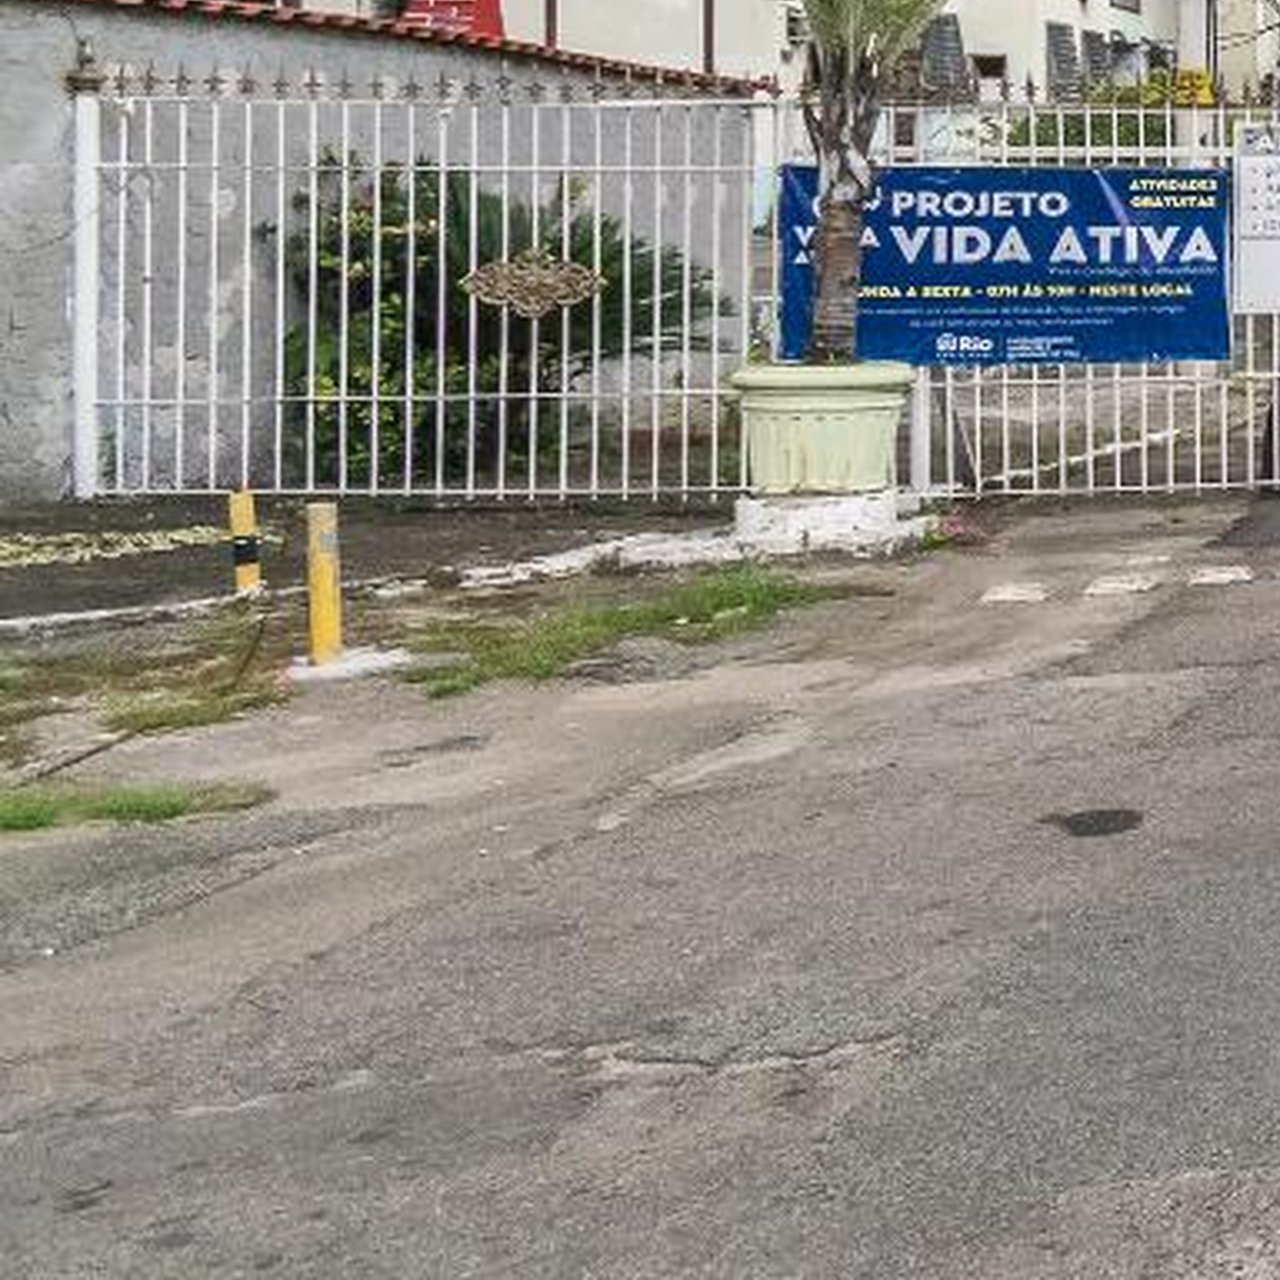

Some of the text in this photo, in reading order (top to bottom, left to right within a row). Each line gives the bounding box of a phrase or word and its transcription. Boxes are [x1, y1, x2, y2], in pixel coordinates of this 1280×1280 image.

[1129, 180, 1218, 191] ATIVIDADES
[892, 191, 1068, 216] PROJETO
[1129, 196, 1216, 207] GRATUITAS
[889, 226, 1218, 263] VIDA ATIVA
